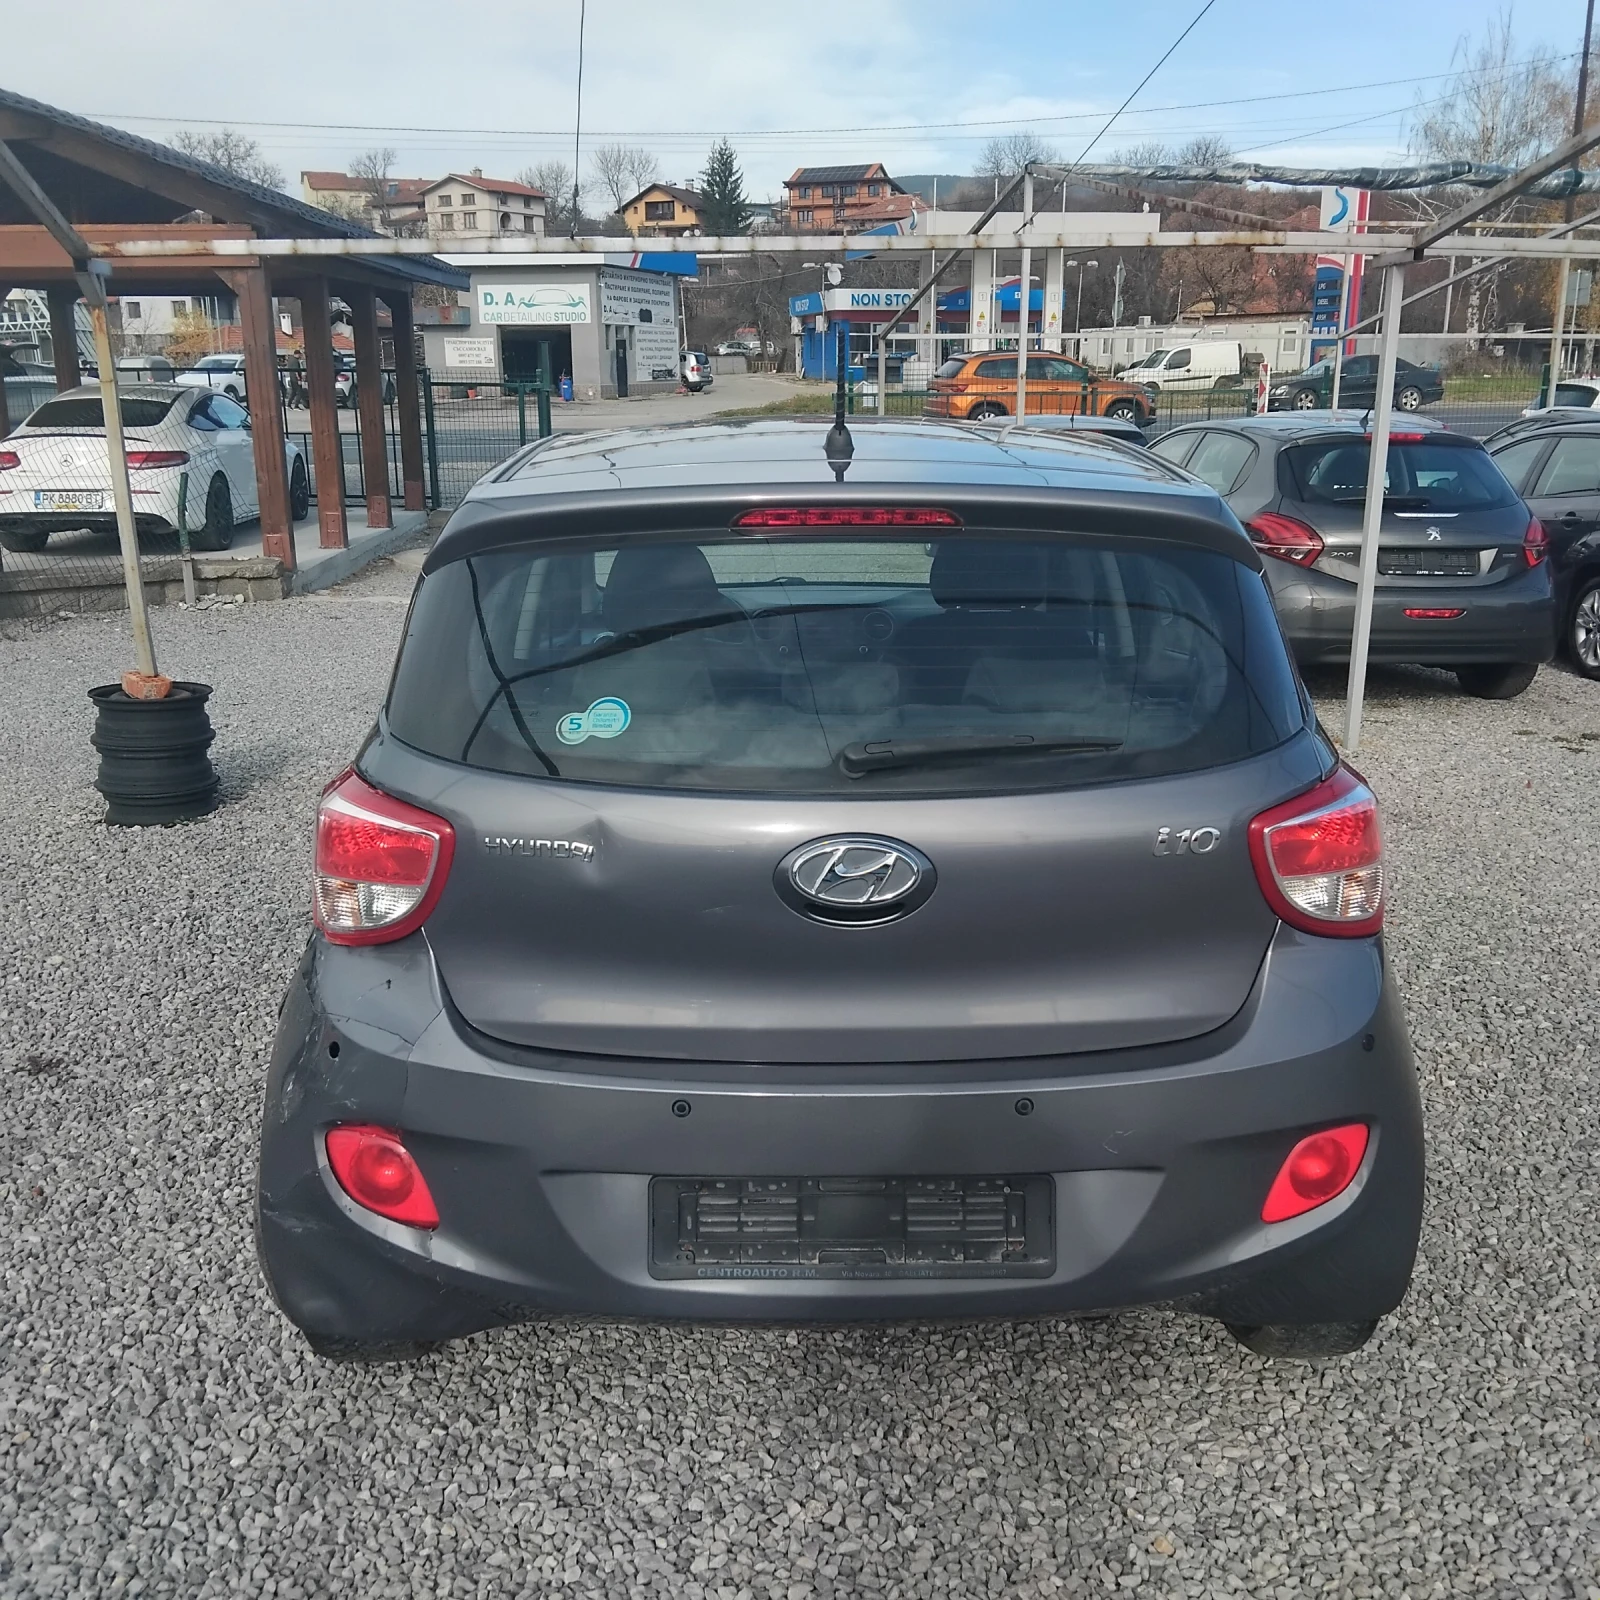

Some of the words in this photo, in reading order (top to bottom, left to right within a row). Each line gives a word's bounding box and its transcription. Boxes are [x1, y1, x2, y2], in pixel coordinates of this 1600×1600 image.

[483, 292, 498, 306] D.
[504, 292, 515, 306] A
[851, 293, 880, 306] NON
[885, 293, 916, 306] STO
[553, 311, 586, 322] STUDIO
[42, 493, 55, 504] PK
[568, 717, 583, 731] 5
[1153, 826, 1221, 857] i10
[484, 837, 596, 864] HYUNDAI
[697, 1268, 788, 1277] CENTROAUTO
[841, 1270, 853, 1278] Via
